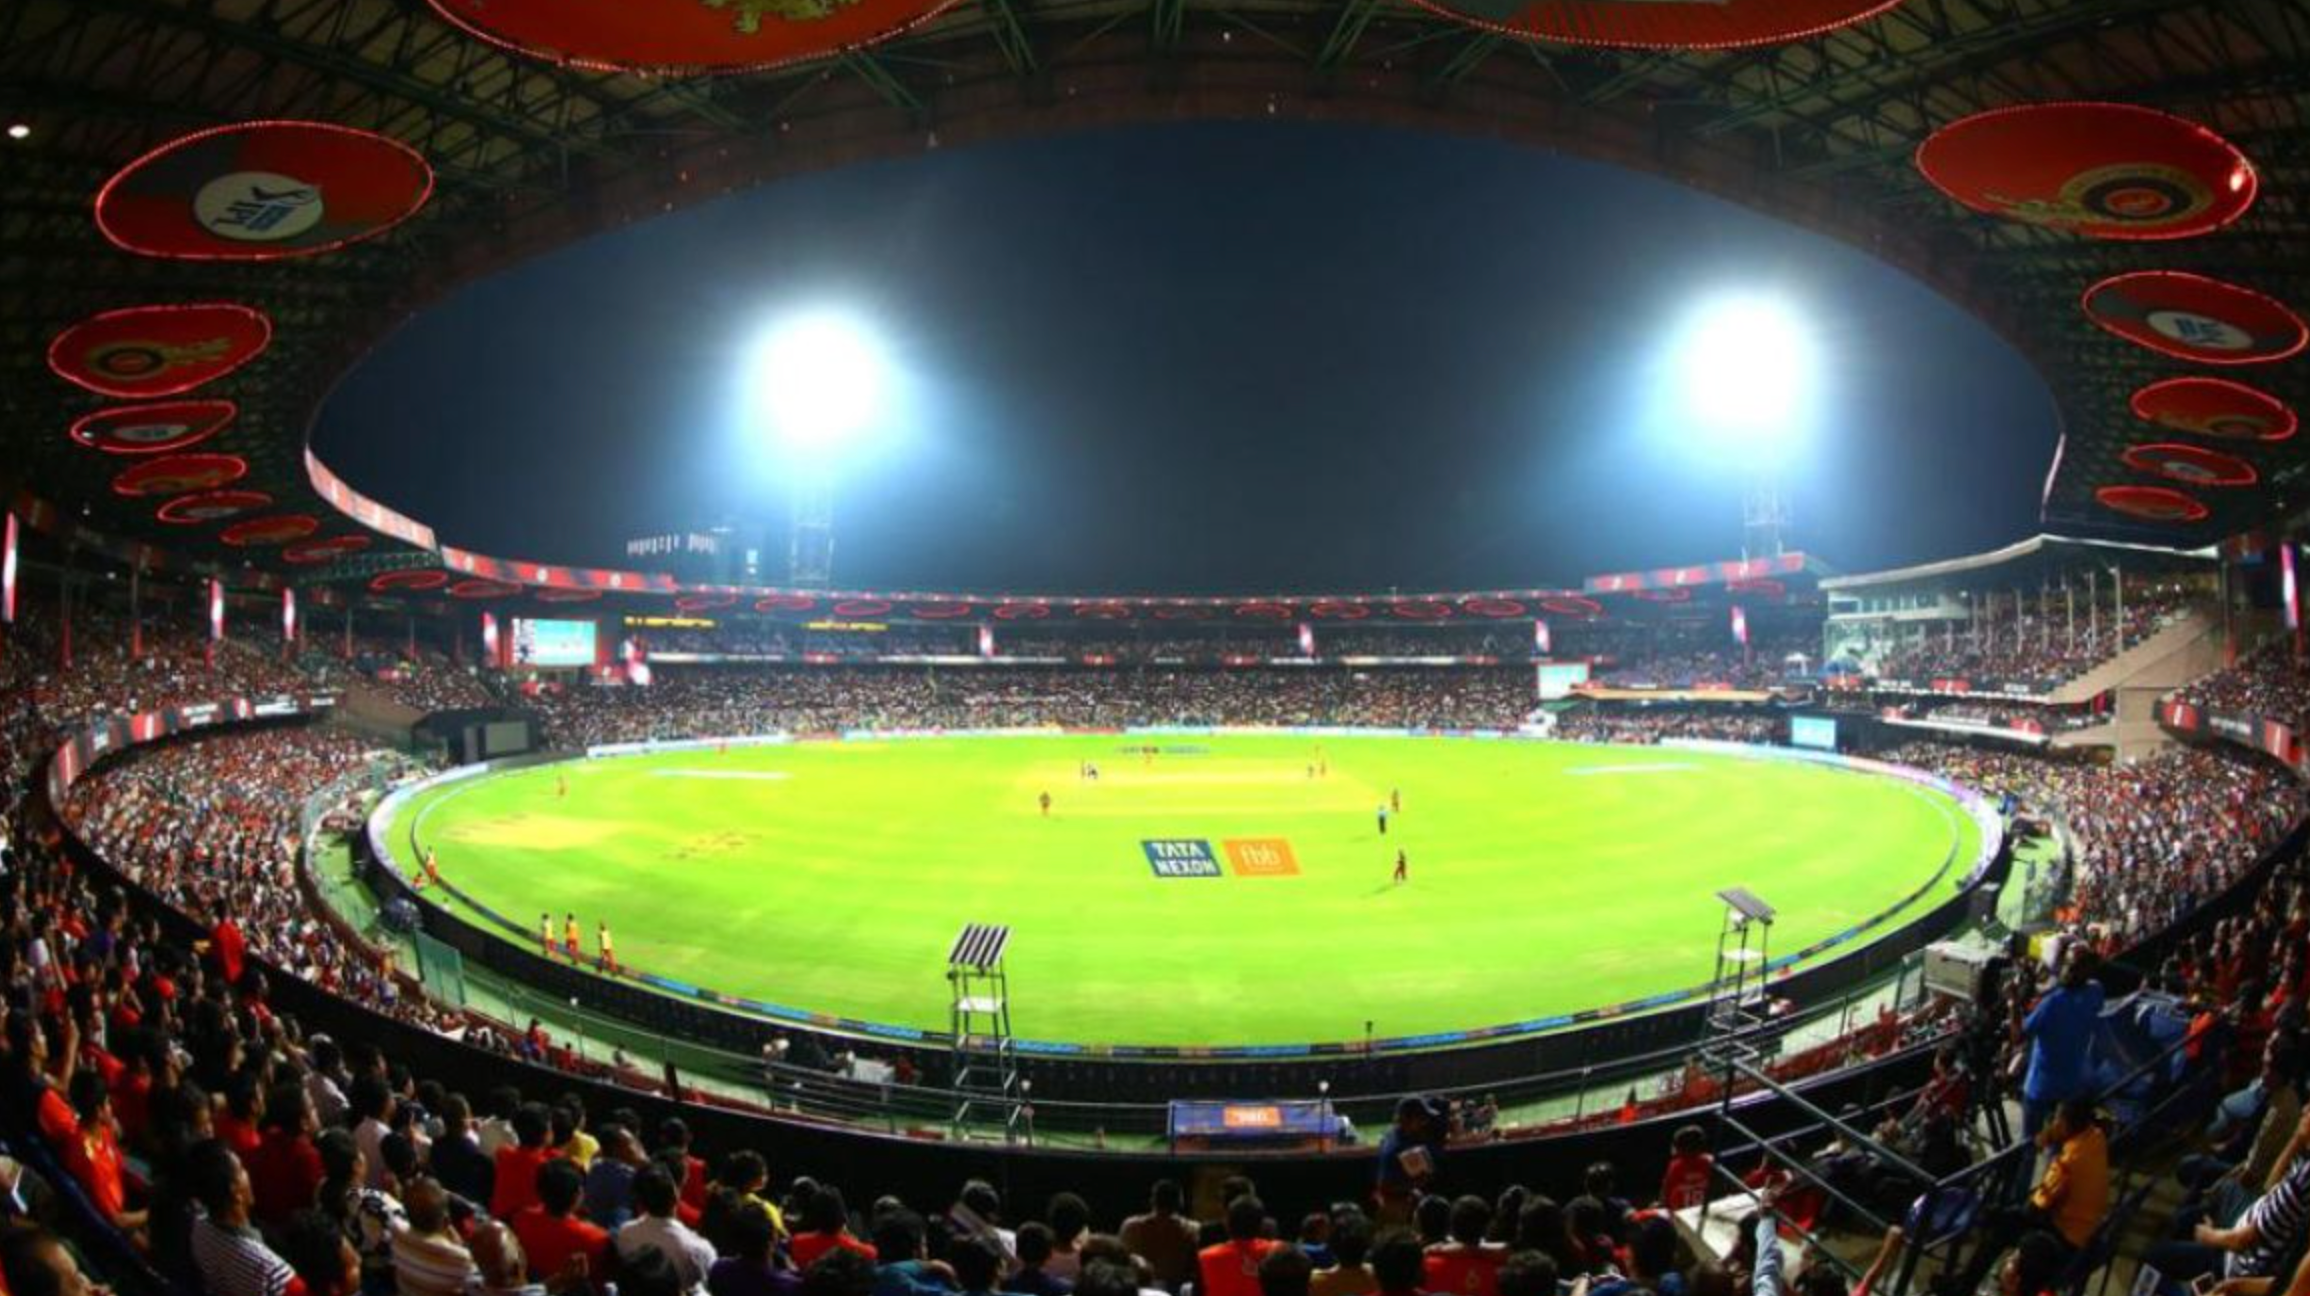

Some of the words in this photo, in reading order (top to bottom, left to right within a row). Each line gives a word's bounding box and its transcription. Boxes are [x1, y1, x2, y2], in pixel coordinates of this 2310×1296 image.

[1151, 842, 1205, 858] TATA
[1239, 844, 1282, 868] fbb
[1154, 859, 1218, 876] NEXON
